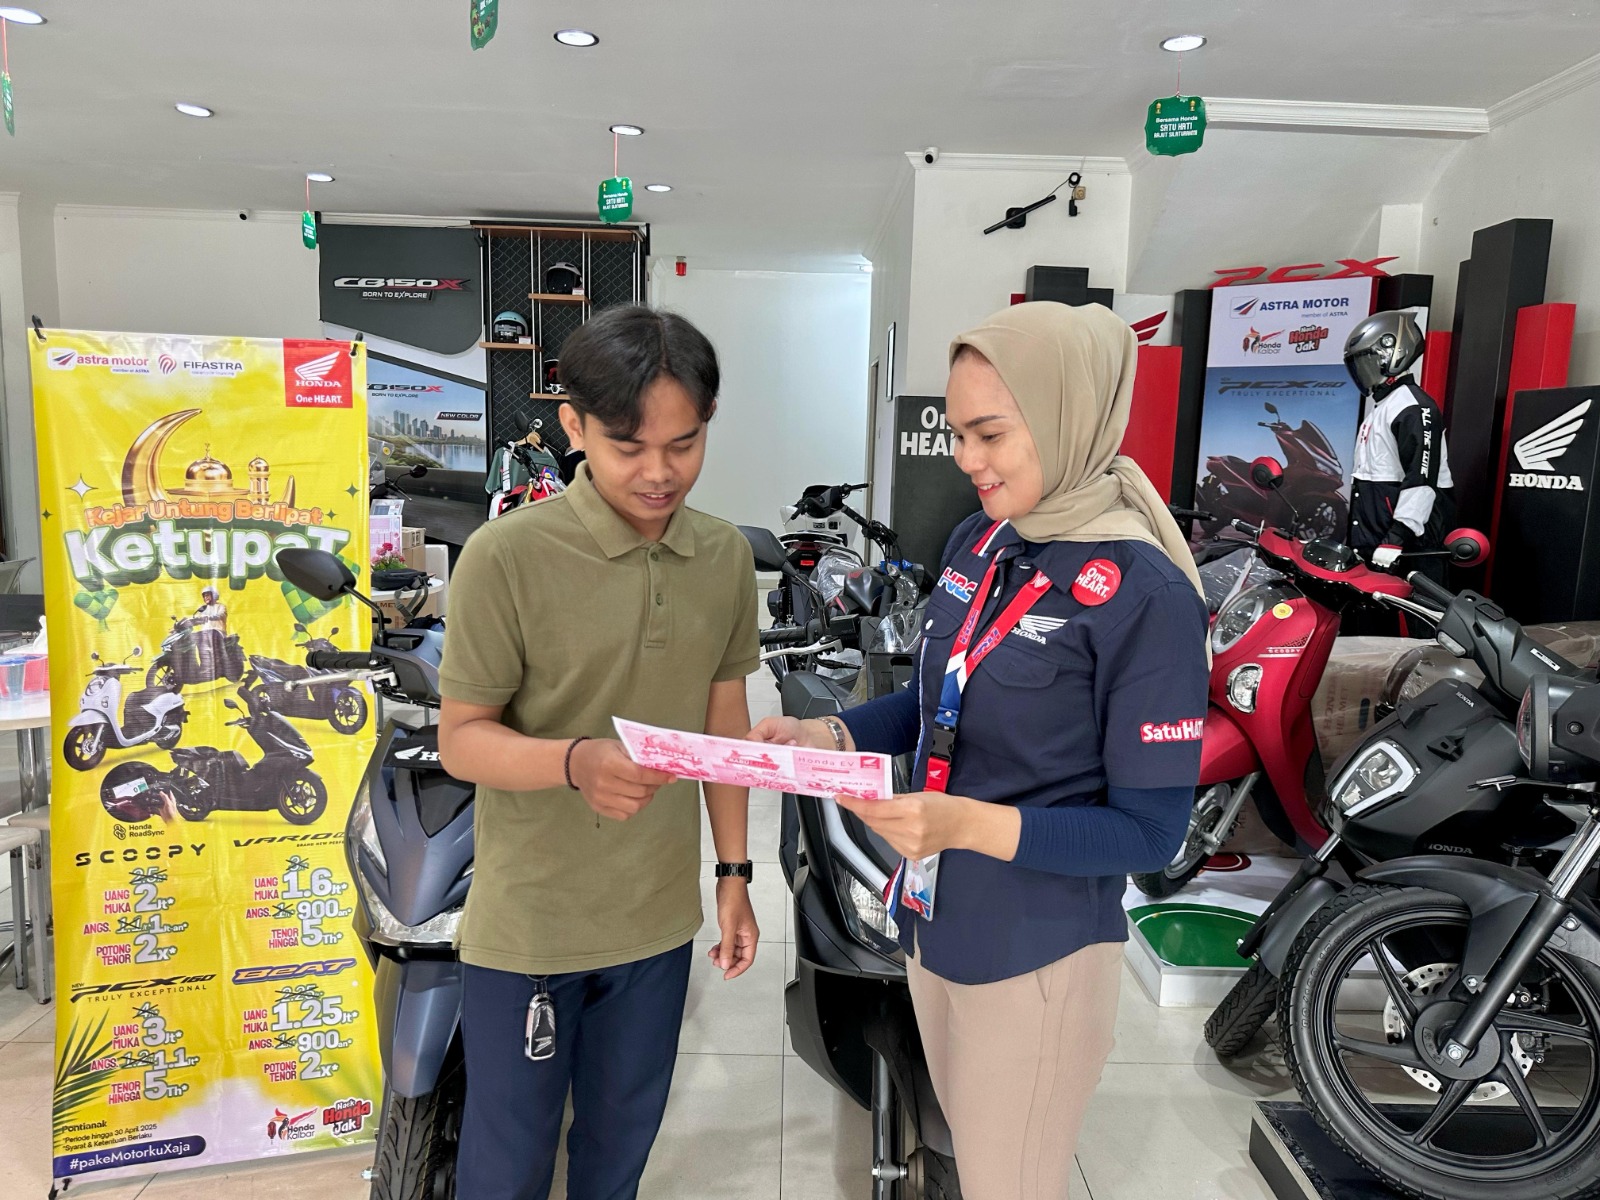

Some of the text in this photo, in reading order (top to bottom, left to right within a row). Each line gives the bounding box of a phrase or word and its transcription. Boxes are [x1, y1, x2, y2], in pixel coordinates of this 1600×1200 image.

[1160, 122, 1193, 131] SATU HATI
[1208, 256, 1400, 289] PCX
[334, 276, 470, 291] CB150X
[394, 291, 428, 299] EXPLORE
[1259, 297, 1349, 311] ASTRA MOTOR
[1288, 326, 1329, 344] Honda
[77, 354, 149, 366] astra motor
[184, 360, 243, 371] FIFASTRA
[295, 380, 342, 388] HONDA
[295, 394, 313, 403] One
[1421, 407, 1432, 427] ALL
[1508, 473, 1584, 491] HONDA
[87, 499, 323, 528] Kejar Untung Berlipat
[1086, 567, 1107, 584] One
[1010, 626, 1047, 645] HONDA
[1455, 691, 1475, 708] HONDA
[798, 756, 835, 766] Honda
[128, 823, 152, 831] Honda
[129, 829, 165, 838] RoadSync
[75, 843, 206, 867] SCOOPY
[254, 876, 279, 888] UANG
[104, 889, 130, 901] UANG
[254, 889, 279, 901] MUKA
[104, 902, 131, 914] MUKA
[245, 907, 272, 919] ANGS.
[83, 921, 112, 935] ANGS.
[271, 927, 299, 938] TENOR
[96, 943, 131, 956] POTONG
[268, 937, 299, 949] HINGGA
[101, 955, 131, 966] TENOR
[88, 984, 207, 1004] TRULY EXCEPTIONAL
[243, 1009, 268, 1021] UANG
[113, 1024, 139, 1036] UANG
[243, 1022, 269, 1034] MUKA
[112, 1037, 140, 1050] MUKA
[248, 1038, 274, 1051] ANGS.
[90, 1057, 119, 1071] ANGS.
[264, 1060, 297, 1073] POTONG
[269, 1071, 297, 1083] TENOR
[111, 1080, 141, 1093] TENOR
[108, 1093, 141, 1105] HINGGA
[323, 1101, 371, 1126] Honda
[61, 1119, 108, 1134] Pontianak
[91, 1131, 114, 1141] hingga
[114, 1128, 124, 1136] 30
[124, 1125, 139, 1135] April
[140, 1123, 158, 1132] 2025
[287, 1123, 315, 1133] Honda
[333, 1116, 362, 1135] Jak!
[93, 1136, 127, 1147] Ketentuan
[127, 1132, 153, 1141] Berlaku
[287, 1130, 315, 1140] Kalbar
[69, 1142, 191, 1171] #pakeMotorkuXaja
